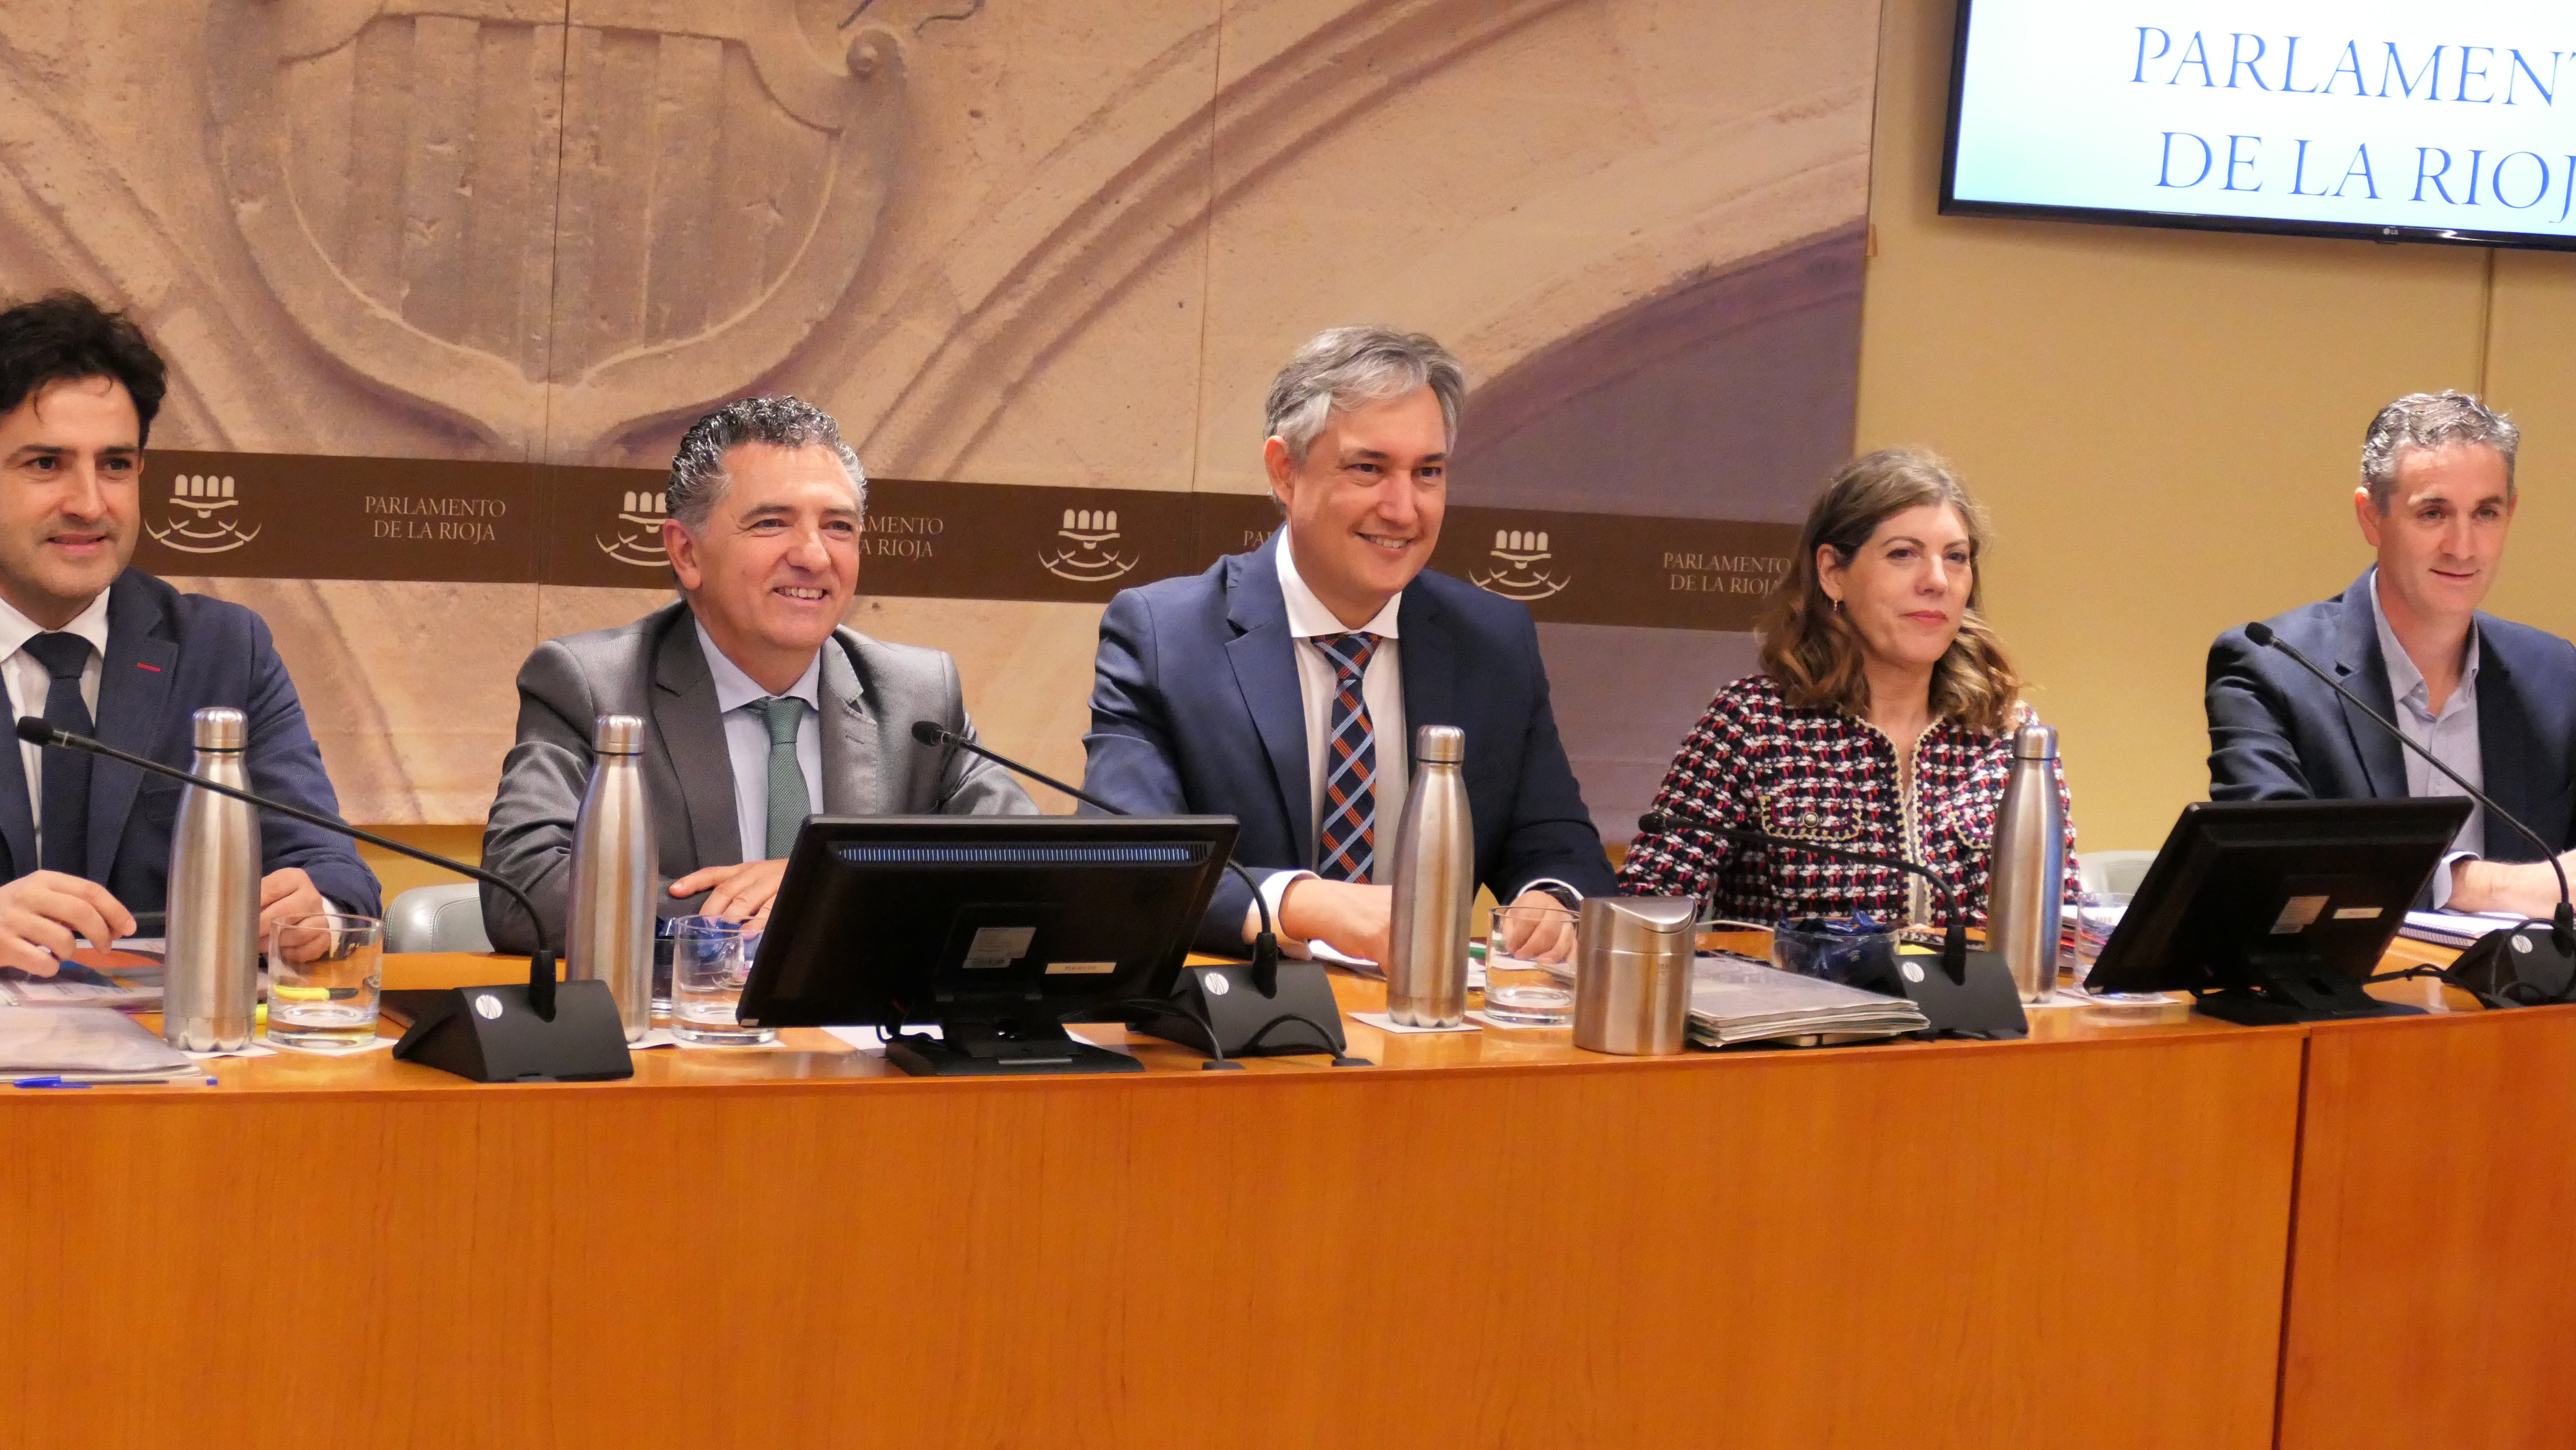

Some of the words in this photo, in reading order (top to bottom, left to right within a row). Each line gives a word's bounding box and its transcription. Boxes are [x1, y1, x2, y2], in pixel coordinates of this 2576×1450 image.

[2129, 27, 2576, 107] PARLAMEN
[2153, 132, 2263, 192] DE
[2287, 139, 2383, 200] LA
[365, 496, 506, 517] PARLAMENTO
[374, 520, 402, 538] DE
[408, 521, 433, 539] LA
[439, 522, 497, 544] RIOJA
[1243, 530, 1275, 547] PA
[859, 539, 871, 555] A
[877, 539, 933, 561] RIOJA
[1663, 552, 1791, 573] PARLAMENTO
[1670, 574, 1696, 590] DE
[1703, 575, 1724, 592] LA
